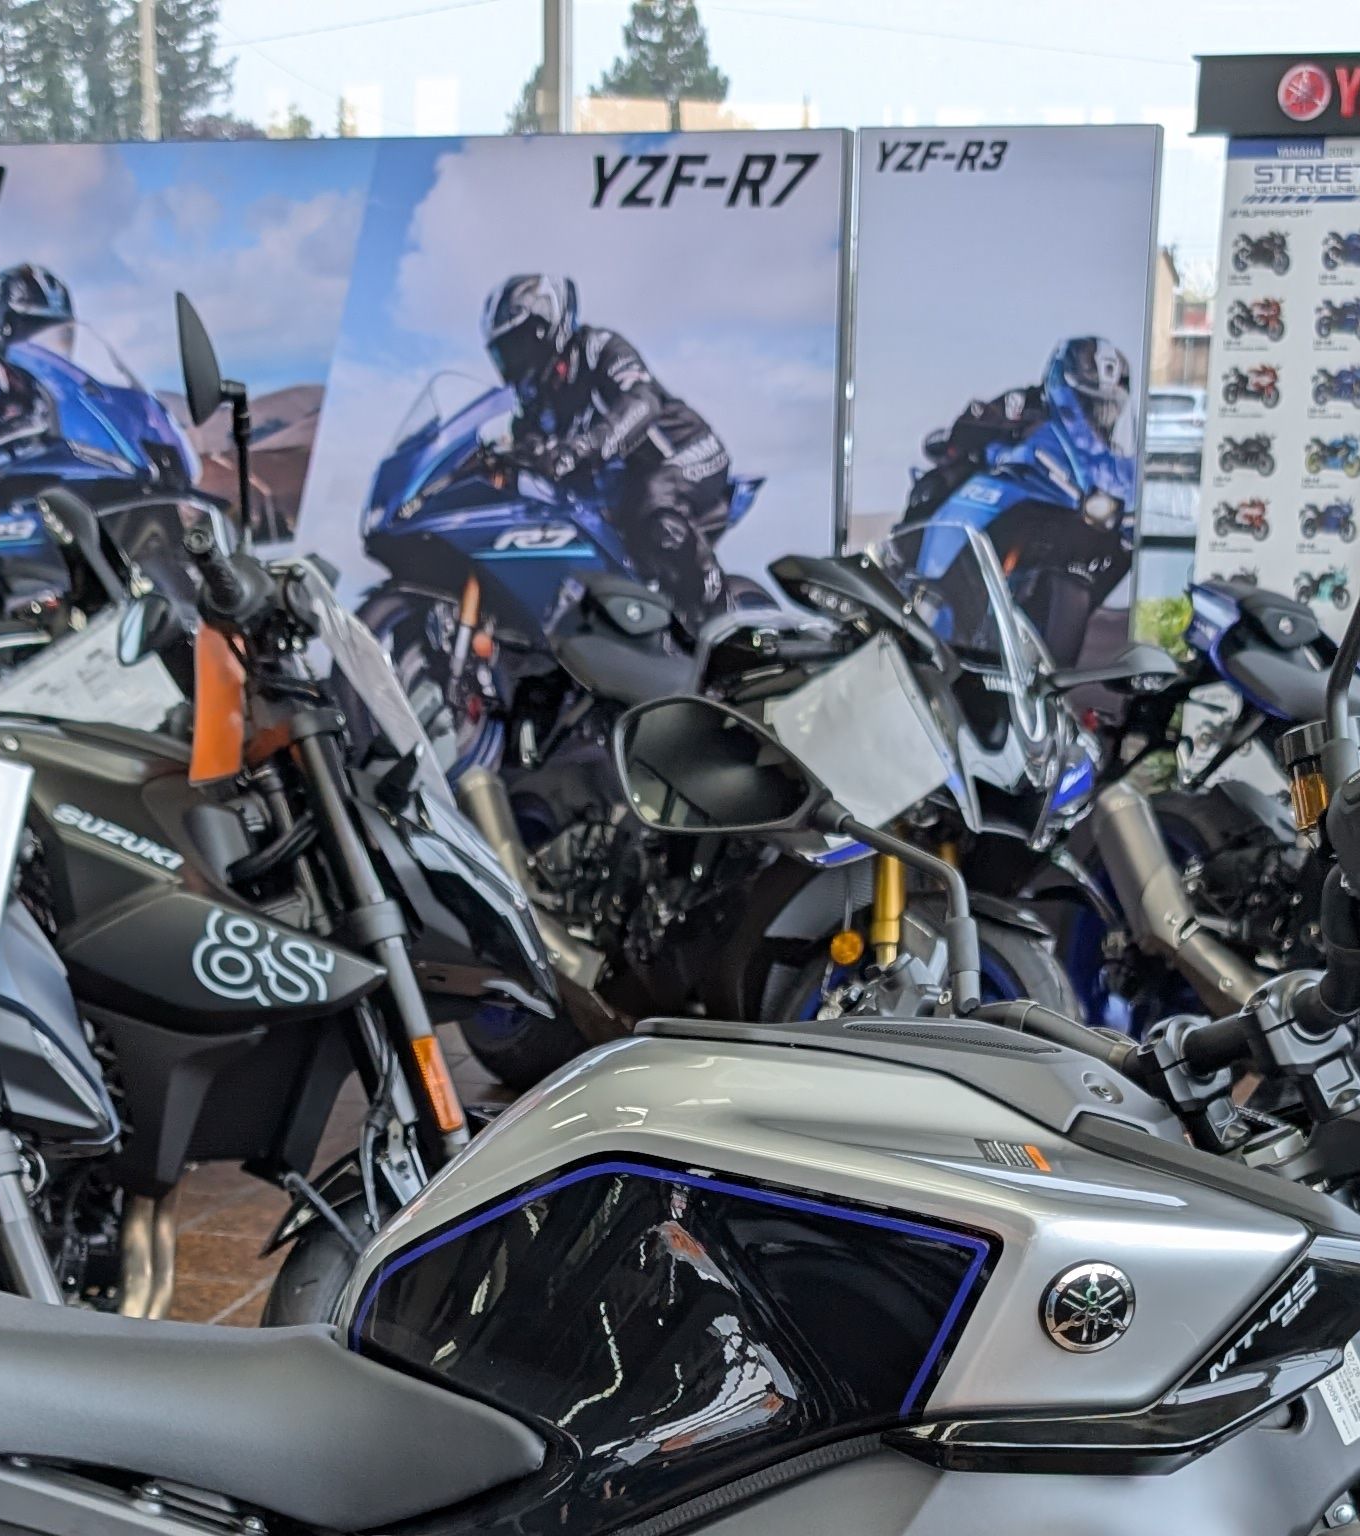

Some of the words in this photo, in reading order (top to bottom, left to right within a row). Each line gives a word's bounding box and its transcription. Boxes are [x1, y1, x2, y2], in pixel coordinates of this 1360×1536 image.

[589, 152, 823, 209] YZF-R7
[874, 140, 1011, 173] YZF-R3
[493, 522, 578, 551] R7
[52, 803, 185, 871] SUZUKI
[1209, 1265, 1316, 1383] MT-09
[1281, 1284, 1319, 1328] SP
